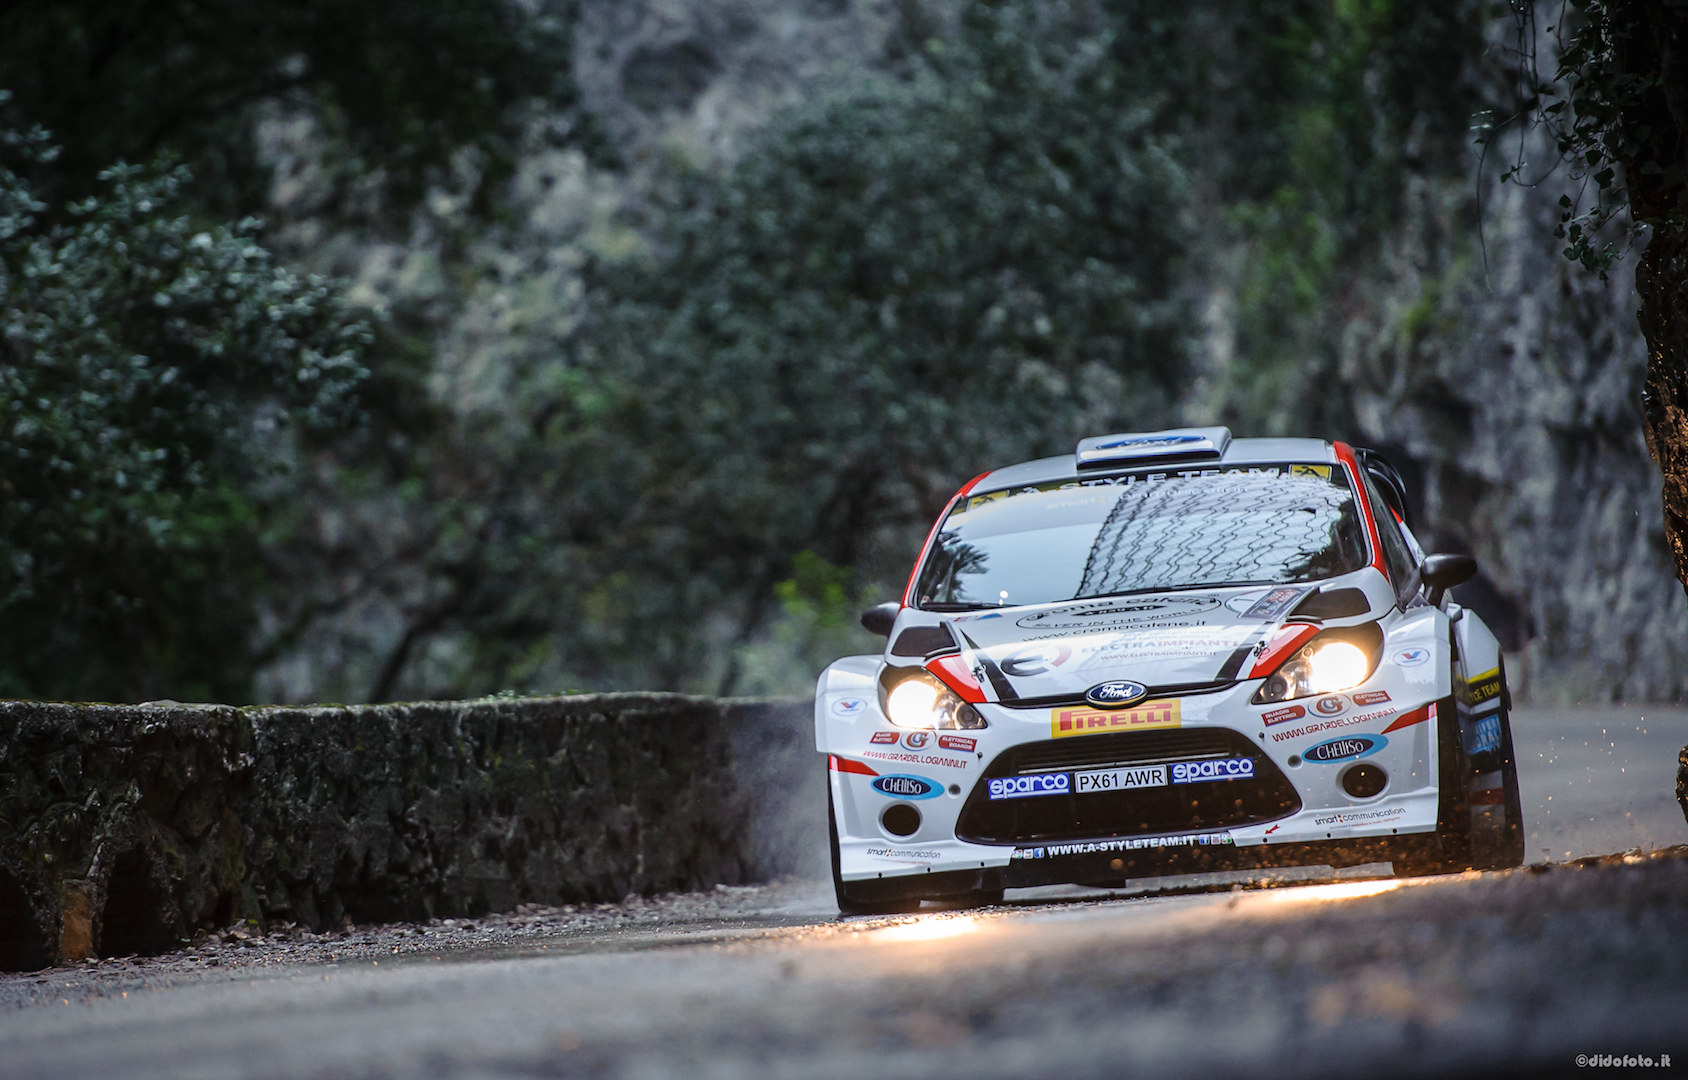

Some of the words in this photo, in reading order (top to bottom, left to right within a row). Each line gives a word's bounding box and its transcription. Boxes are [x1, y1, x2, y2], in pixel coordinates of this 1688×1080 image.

[1099, 683, 1136, 699] Ford
[1060, 702, 1173, 731] PIRELLI
[1079, 772, 1120, 791] PX61
[1124, 769, 1164, 787] AWR
[1172, 758, 1254, 783] sparco
[989, 772, 1069, 798] sparco
[1048, 835, 1196, 857] WWW.A-STYLETEAM.IT
